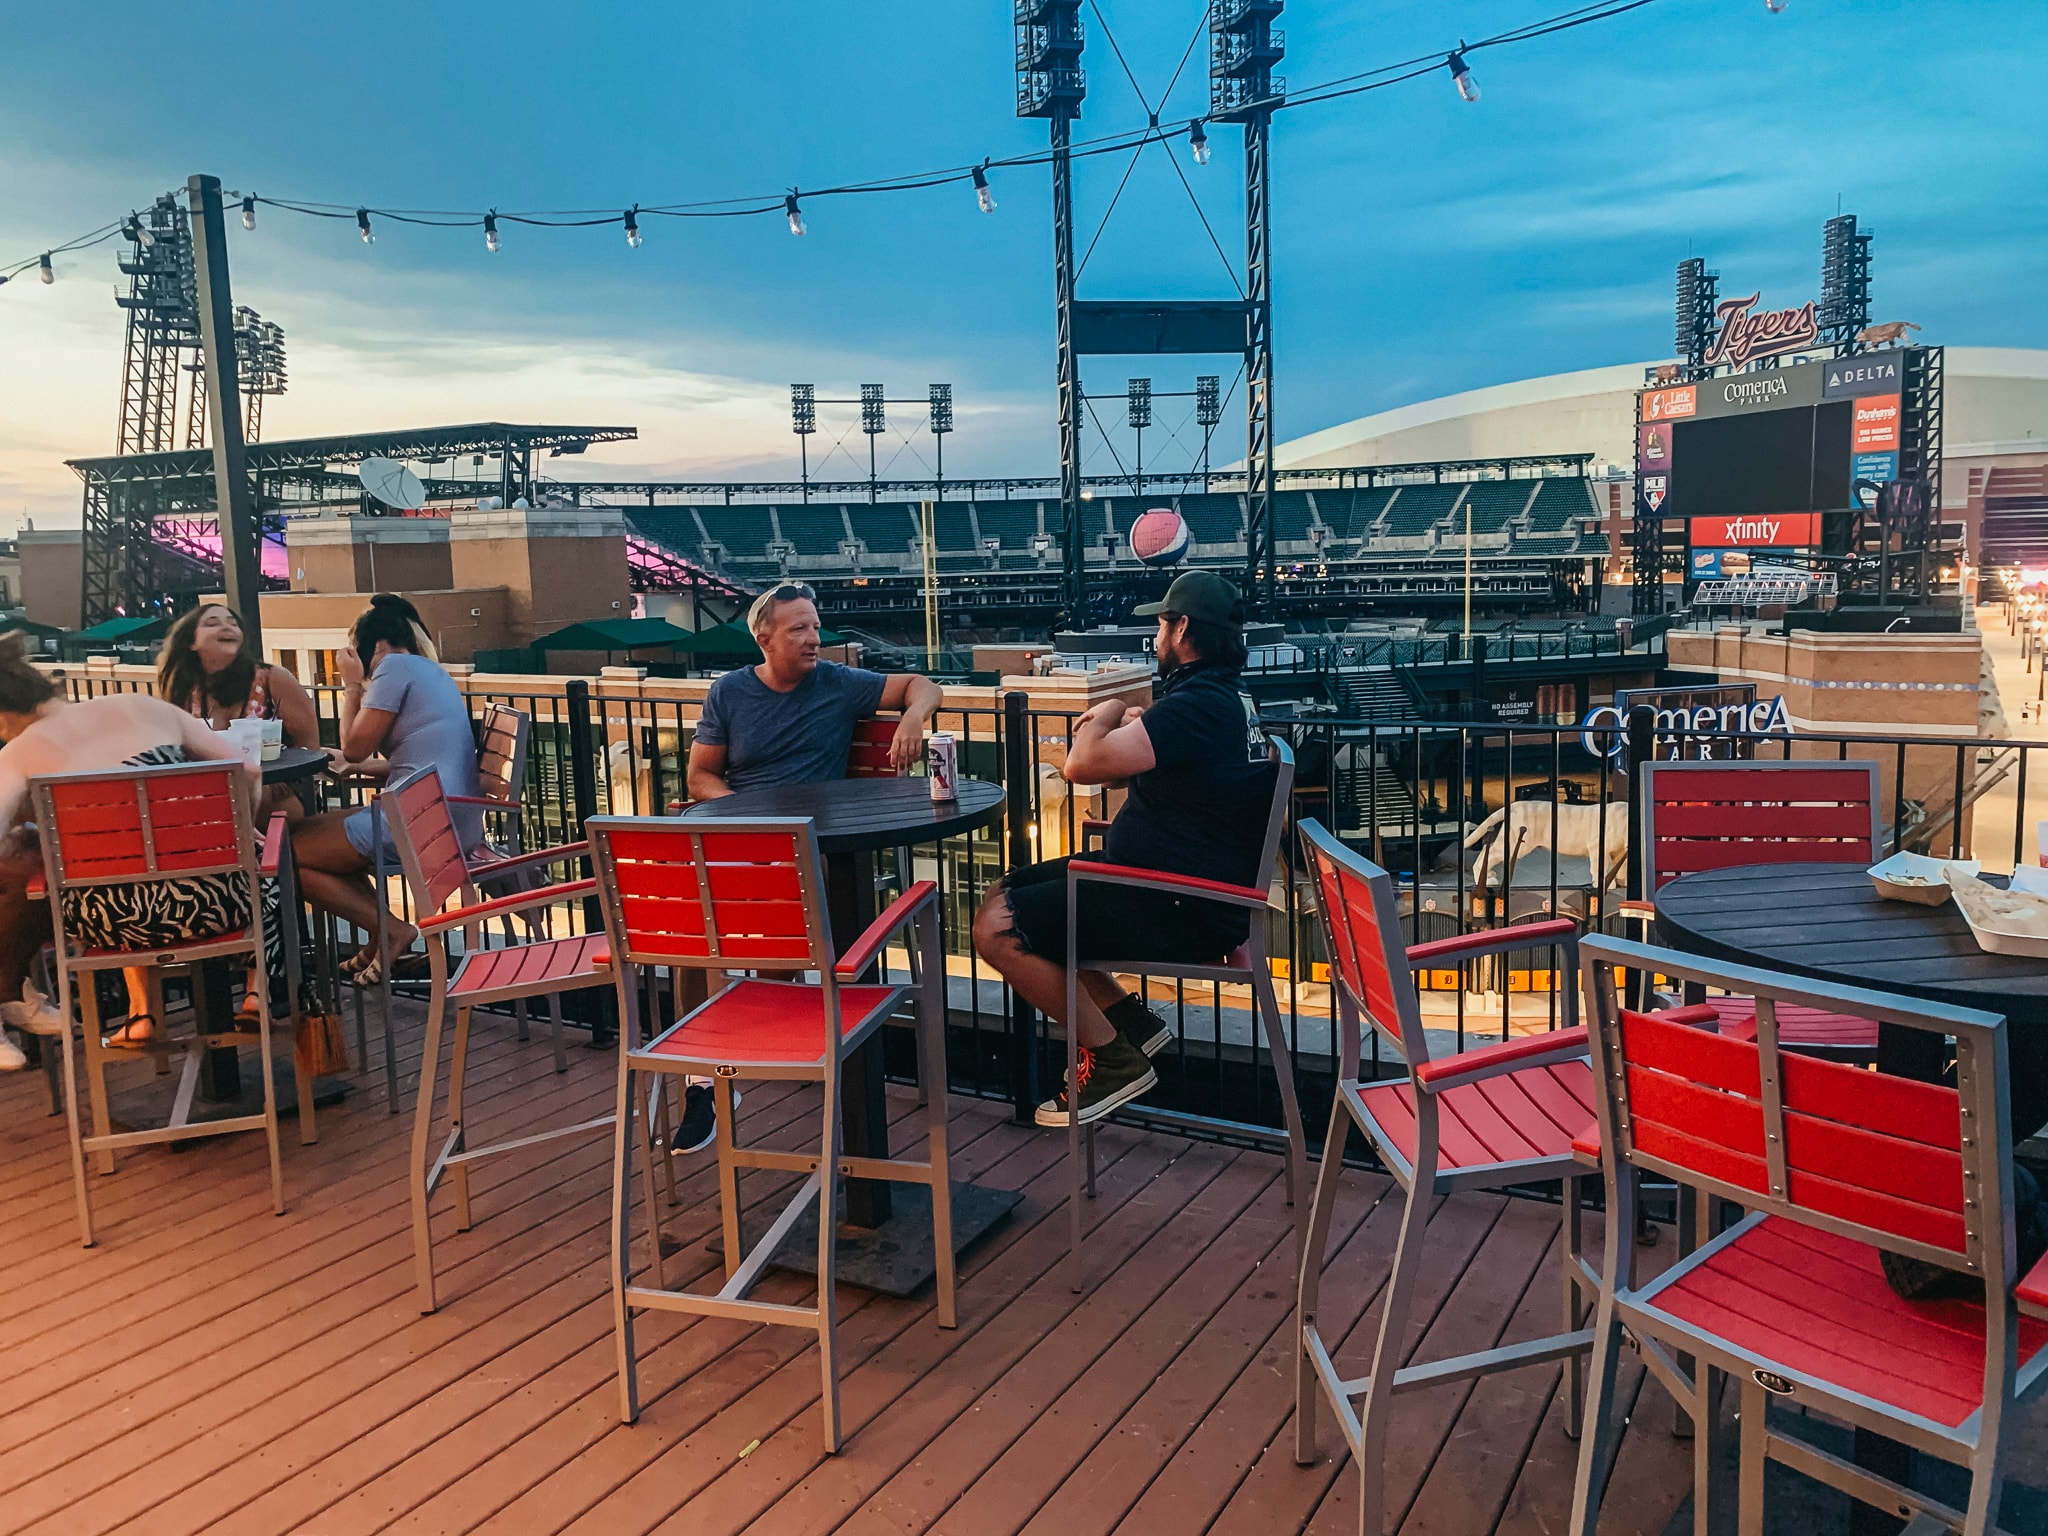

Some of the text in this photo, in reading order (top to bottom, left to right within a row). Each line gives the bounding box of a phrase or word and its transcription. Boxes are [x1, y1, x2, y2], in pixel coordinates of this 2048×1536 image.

[1704, 291, 1818, 373] Tigers
[1844, 364, 1895, 384] DELTA
[1670, 391, 1690, 403] Little
[1740, 394, 1770, 406] PARK
[1664, 402, 1694, 415] Caesars
[1645, 479, 1664, 489] MLB
[1725, 517, 1780, 545] xfinity
[1501, 701, 1534, 710] ASSEMBLY
[1497, 708, 1529, 716] REQUIRED
